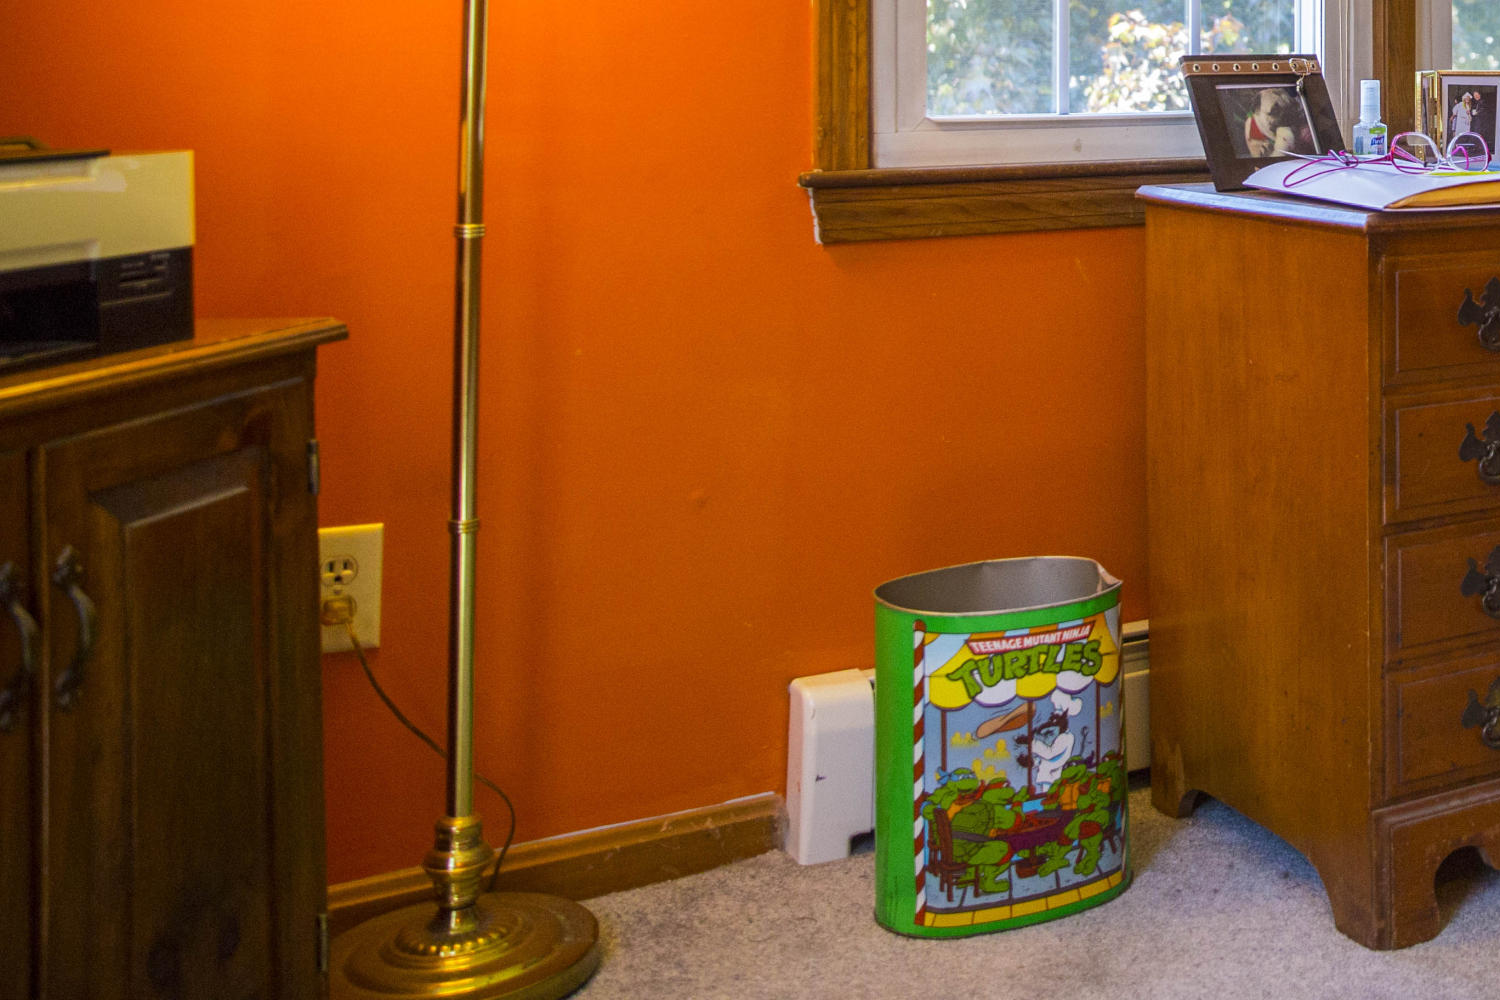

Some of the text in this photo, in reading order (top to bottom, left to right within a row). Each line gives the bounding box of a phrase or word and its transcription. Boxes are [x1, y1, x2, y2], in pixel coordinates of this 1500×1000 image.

[969, 625, 1091, 653] TEENAGE MUTANT NINJA
[946, 640, 1103, 700] TURTLES
